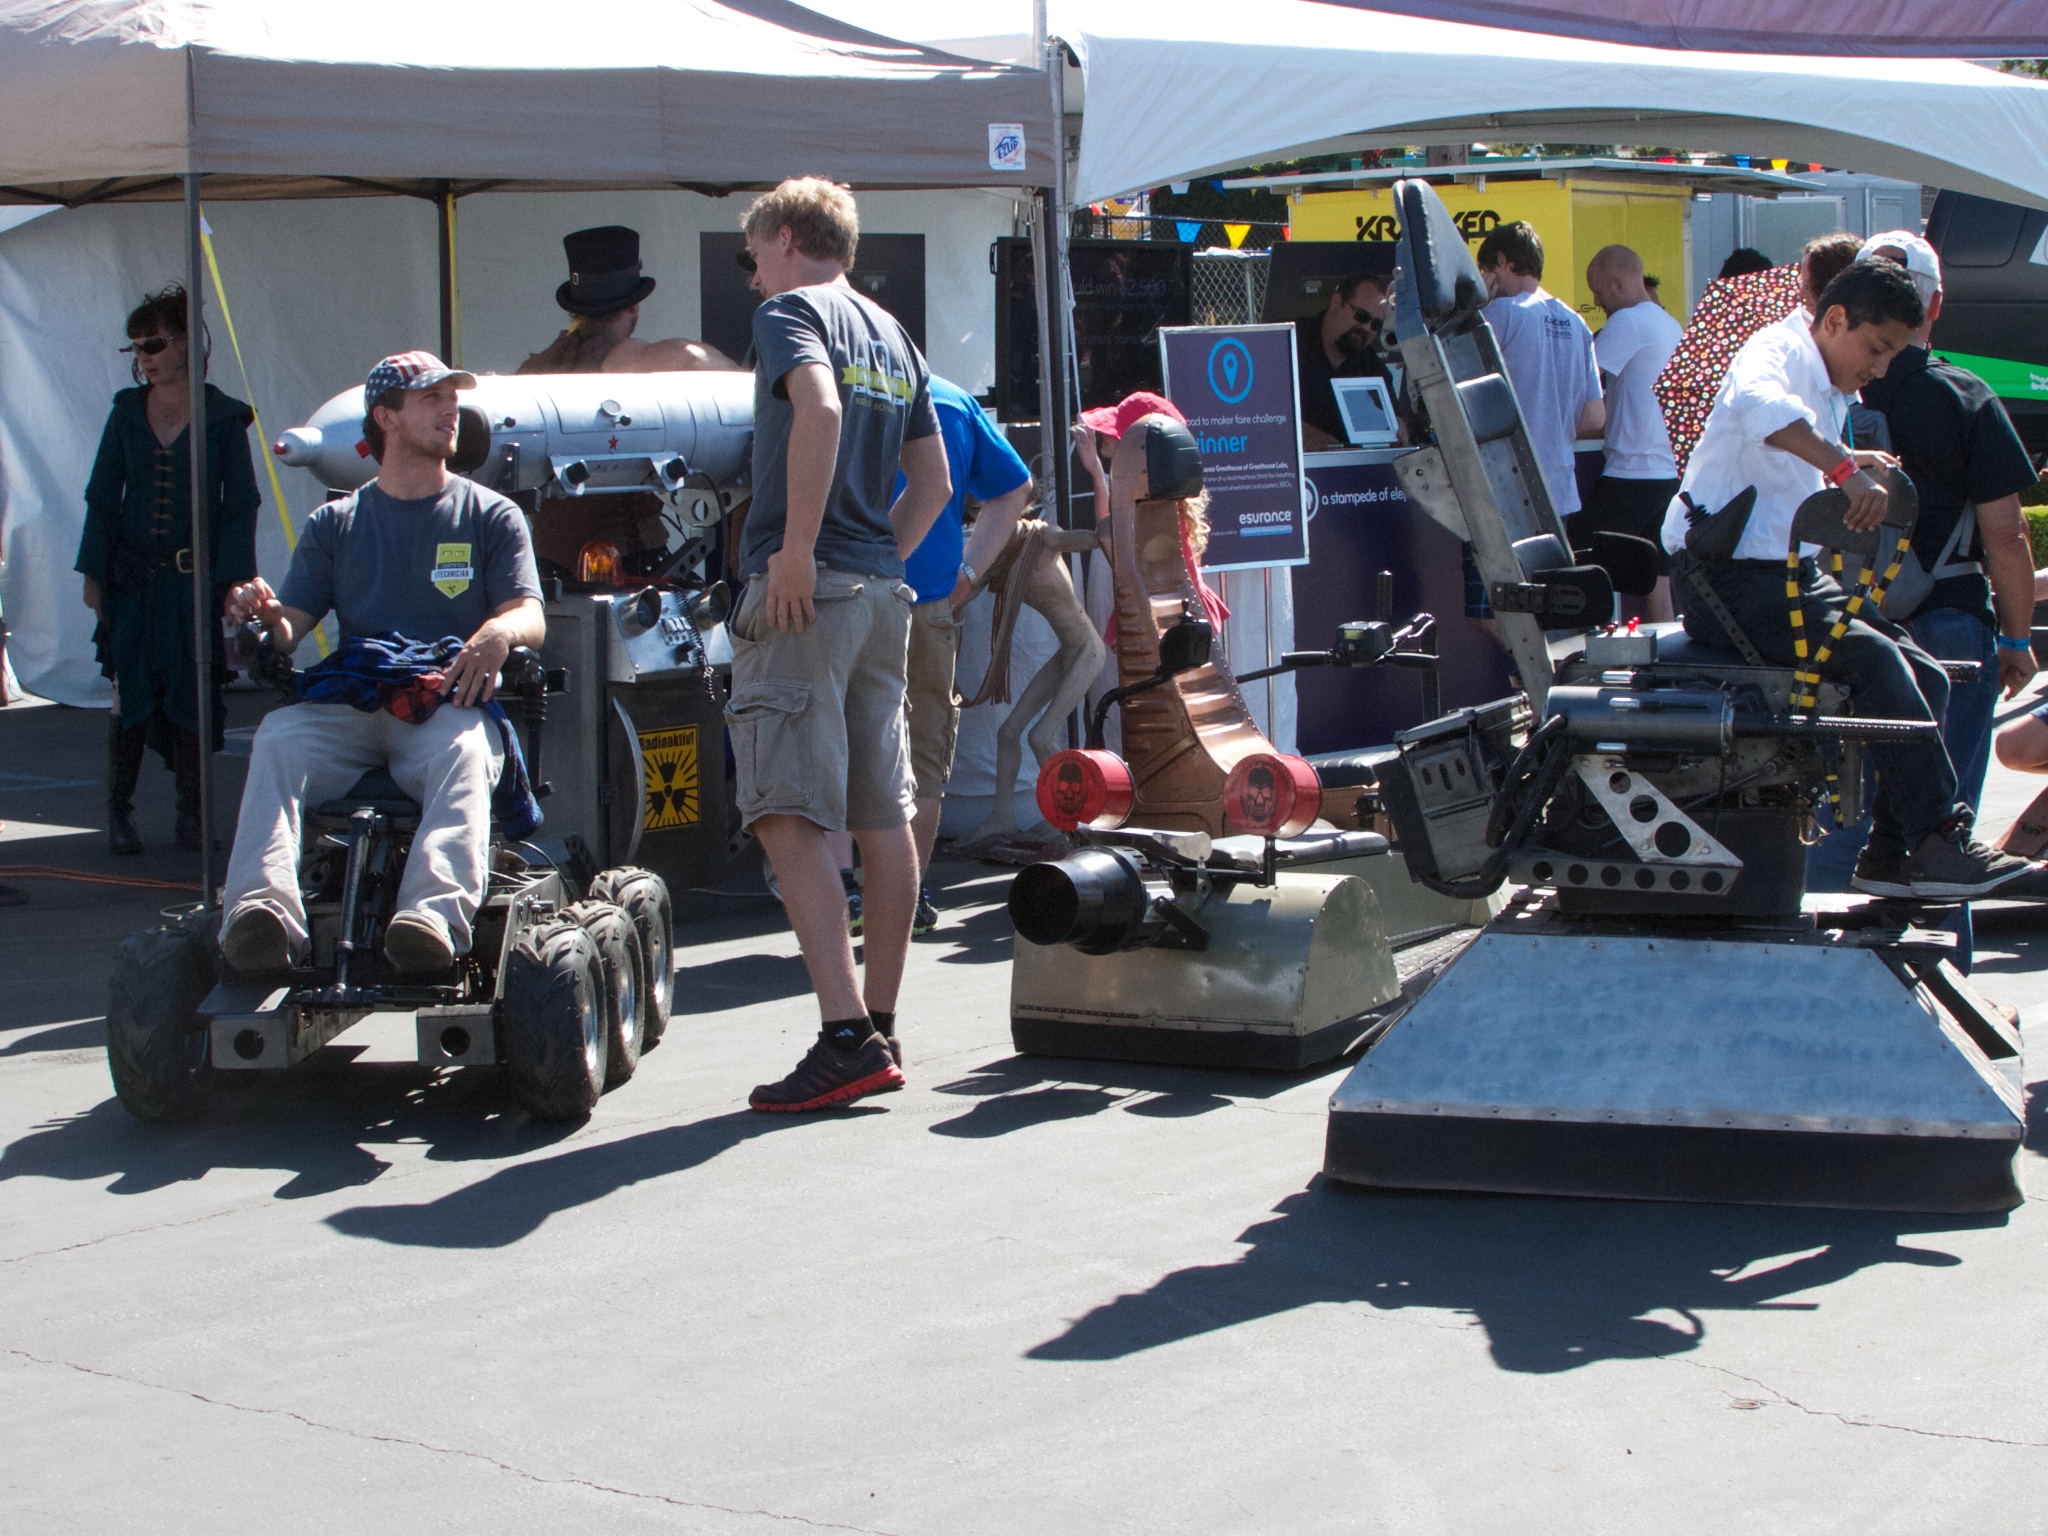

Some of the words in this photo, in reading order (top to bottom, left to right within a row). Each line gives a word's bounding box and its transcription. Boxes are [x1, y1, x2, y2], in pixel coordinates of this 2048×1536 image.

[1201, 416, 1210, 426] to
[1210, 413, 1234, 425] maker
[1235, 413, 1251, 425] faire
[1251, 412, 1287, 425] challenge
[1196, 431, 1248, 454] inner
[1321, 495, 1329, 506] a
[1330, 488, 1378, 507] stampede
[1378, 486, 1389, 502] of
[1238, 510, 1292, 525] esurance
